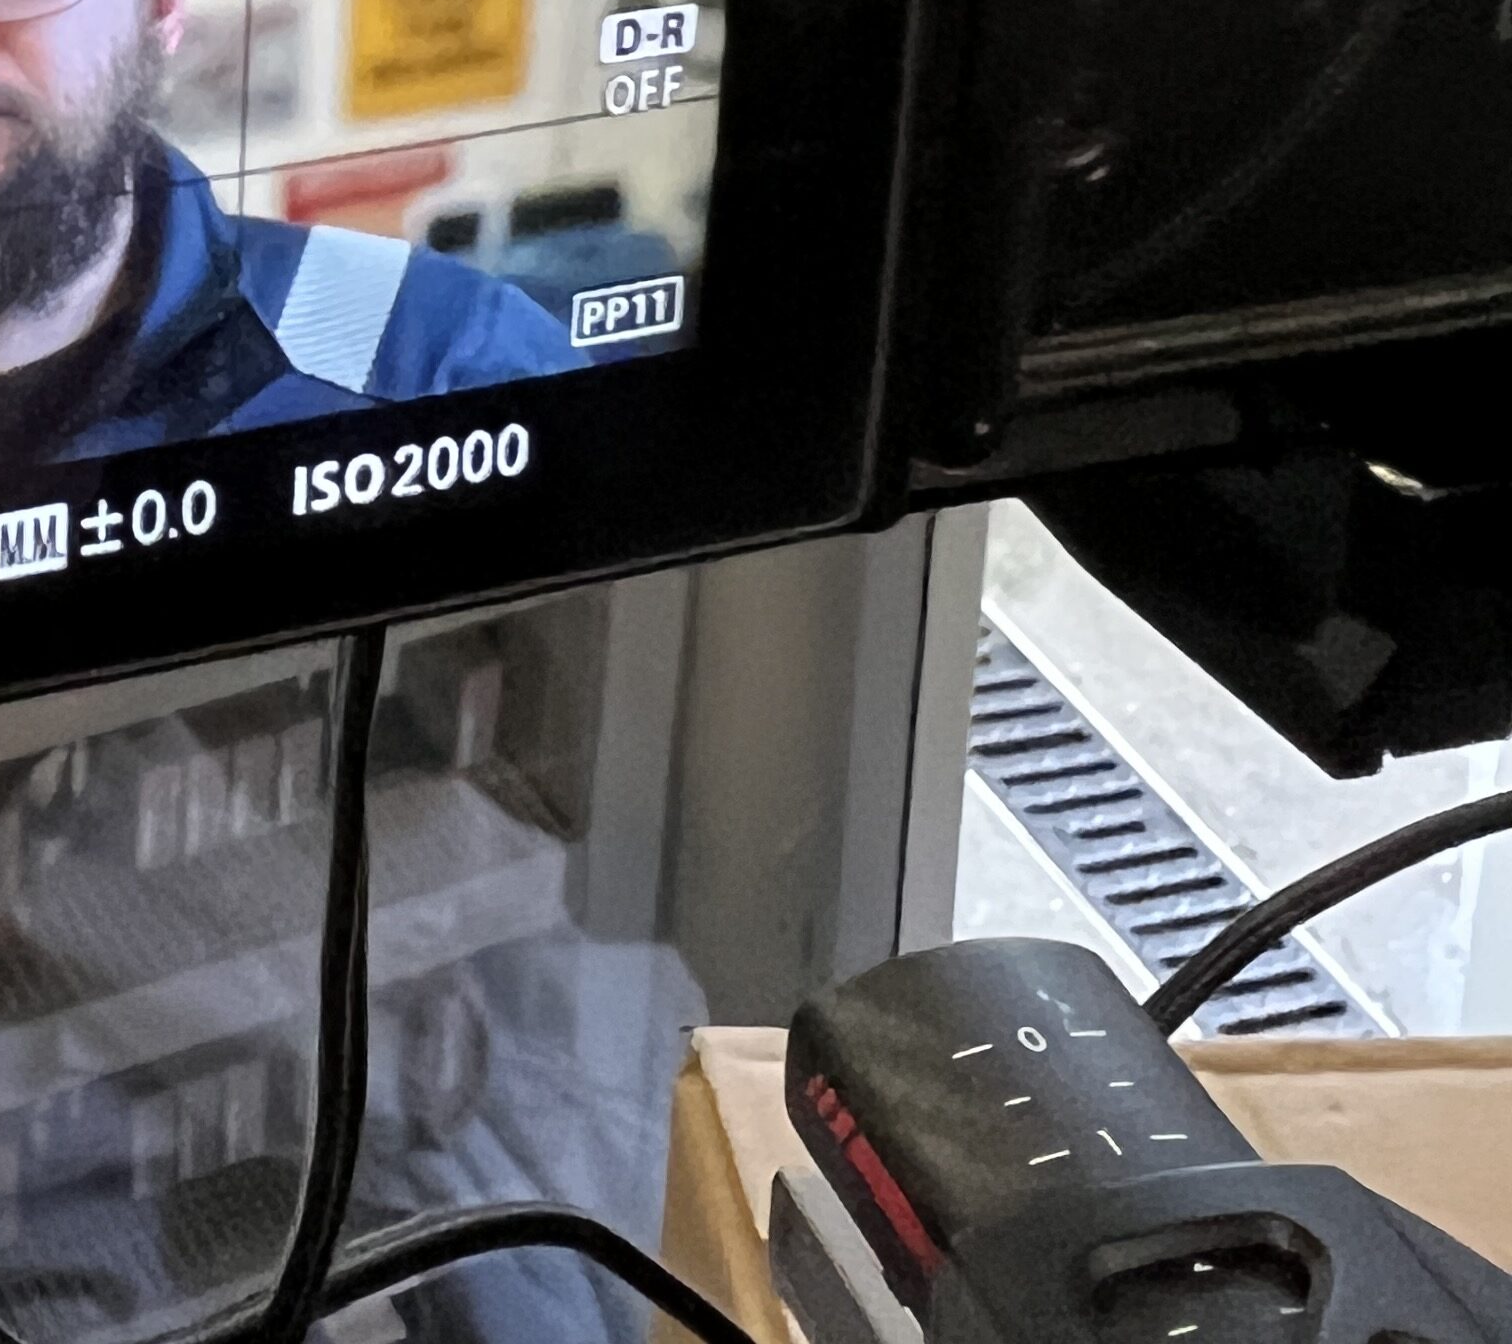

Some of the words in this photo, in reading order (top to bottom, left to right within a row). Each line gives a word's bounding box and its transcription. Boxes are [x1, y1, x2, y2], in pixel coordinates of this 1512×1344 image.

[615, 11, 685, 56] D-R
[604, 65, 684, 116] OFF
[583, 289, 667, 335] PP11
[292, 458, 385, 516] ISO
[390, 422, 530, 498] 2000
